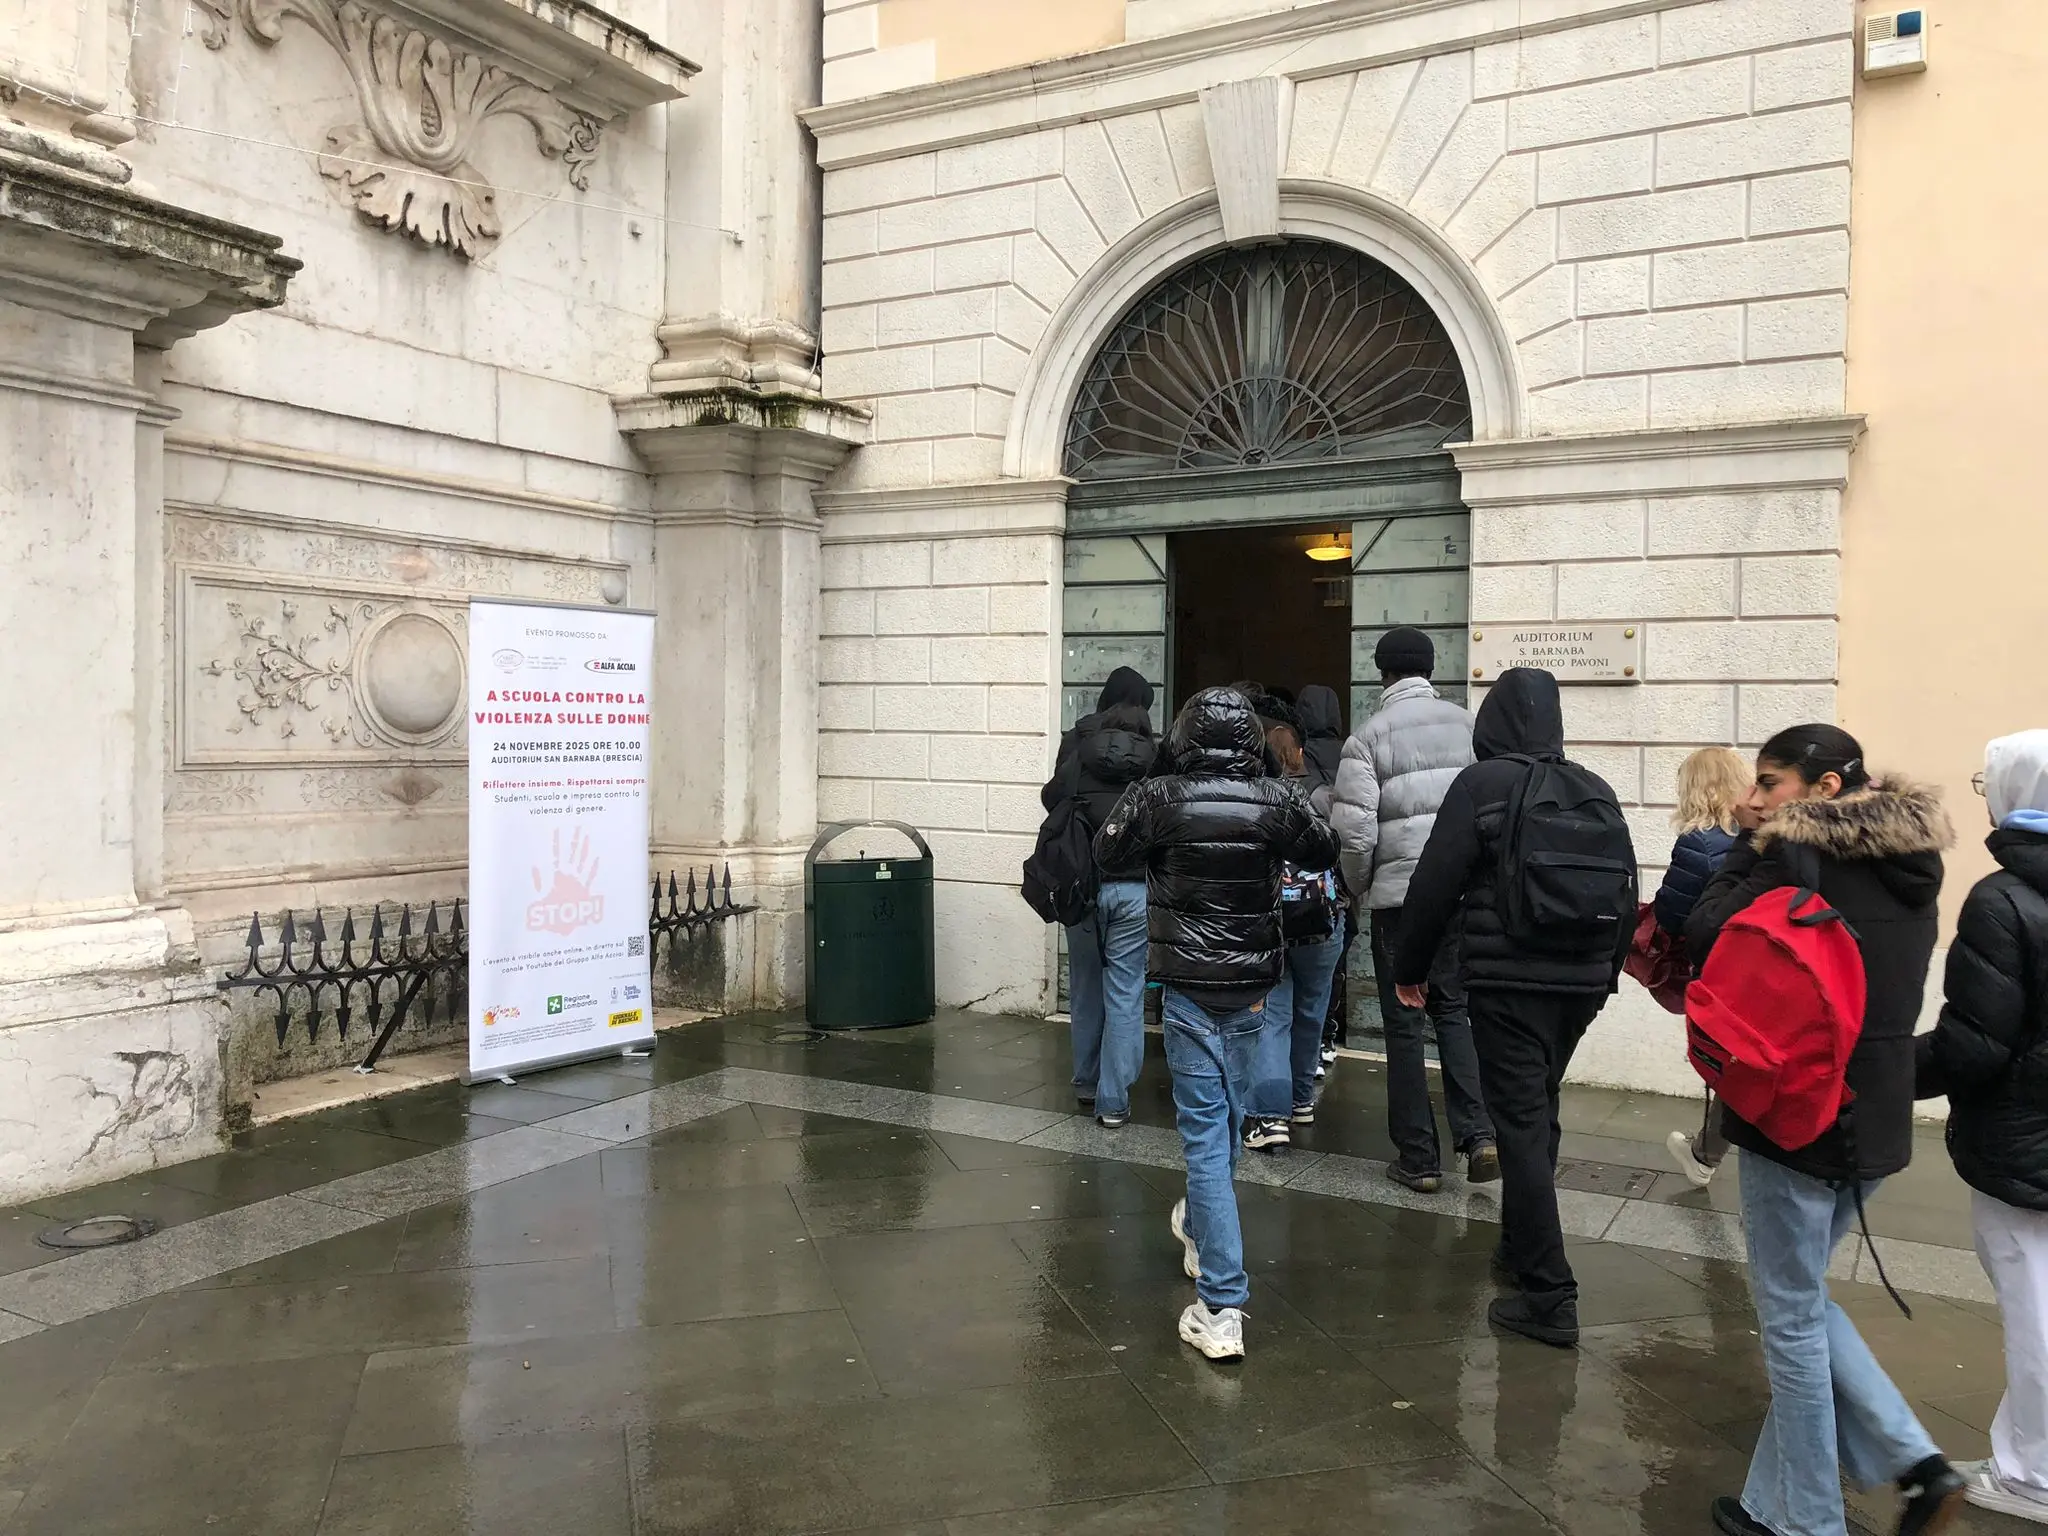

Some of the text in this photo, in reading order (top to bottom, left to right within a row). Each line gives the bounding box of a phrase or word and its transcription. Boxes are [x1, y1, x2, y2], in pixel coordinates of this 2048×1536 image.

[526, 628, 554, 637] EVENTO
[555, 630, 596, 640] PROMOSSO
[1512, 632, 1593, 643] AUDITORIUM
[1519, 647, 1585, 656] S. BARNABA
[601, 662, 636, 671] ALFA ACCIAI
[1496, 658, 1609, 668] S. LODOVICO PAVONI
[487, 690, 645, 704] A SCUOLA CONTRO LA
[475, 712, 650, 724] VIOLENZA SULLE DONNE
[493, 741, 641, 751] 24 NOVEMBRE 2025 ORE 10.00
[491, 754, 643, 764] AUDITORIUM SAN BARNABA (BRESCIA)
[482, 777, 648, 789] Riflettere insieme. Rispettarsi sempre.
[494, 793, 532, 803] Studenti,
[534, 792, 560, 801] scuola
[604, 791, 630, 799] contro
[529, 805, 607, 815] violenza di genere.
[530, 901, 600, 926] STOP!
[483, 956, 510, 966] L'evento
[518, 951, 541, 960] visibile
[543, 949, 562, 957] anche
[593, 942, 614, 951] diretta
[502, 965, 524, 974] canale
[526, 961, 552, 970] Youtube
[554, 958, 565, 967] del
[566, 956, 589, 965] Gruppo
[605, 951, 624, 959] Acciai
[564, 993, 591, 1003] Regione
[564, 999, 598, 1010] Lombardia
